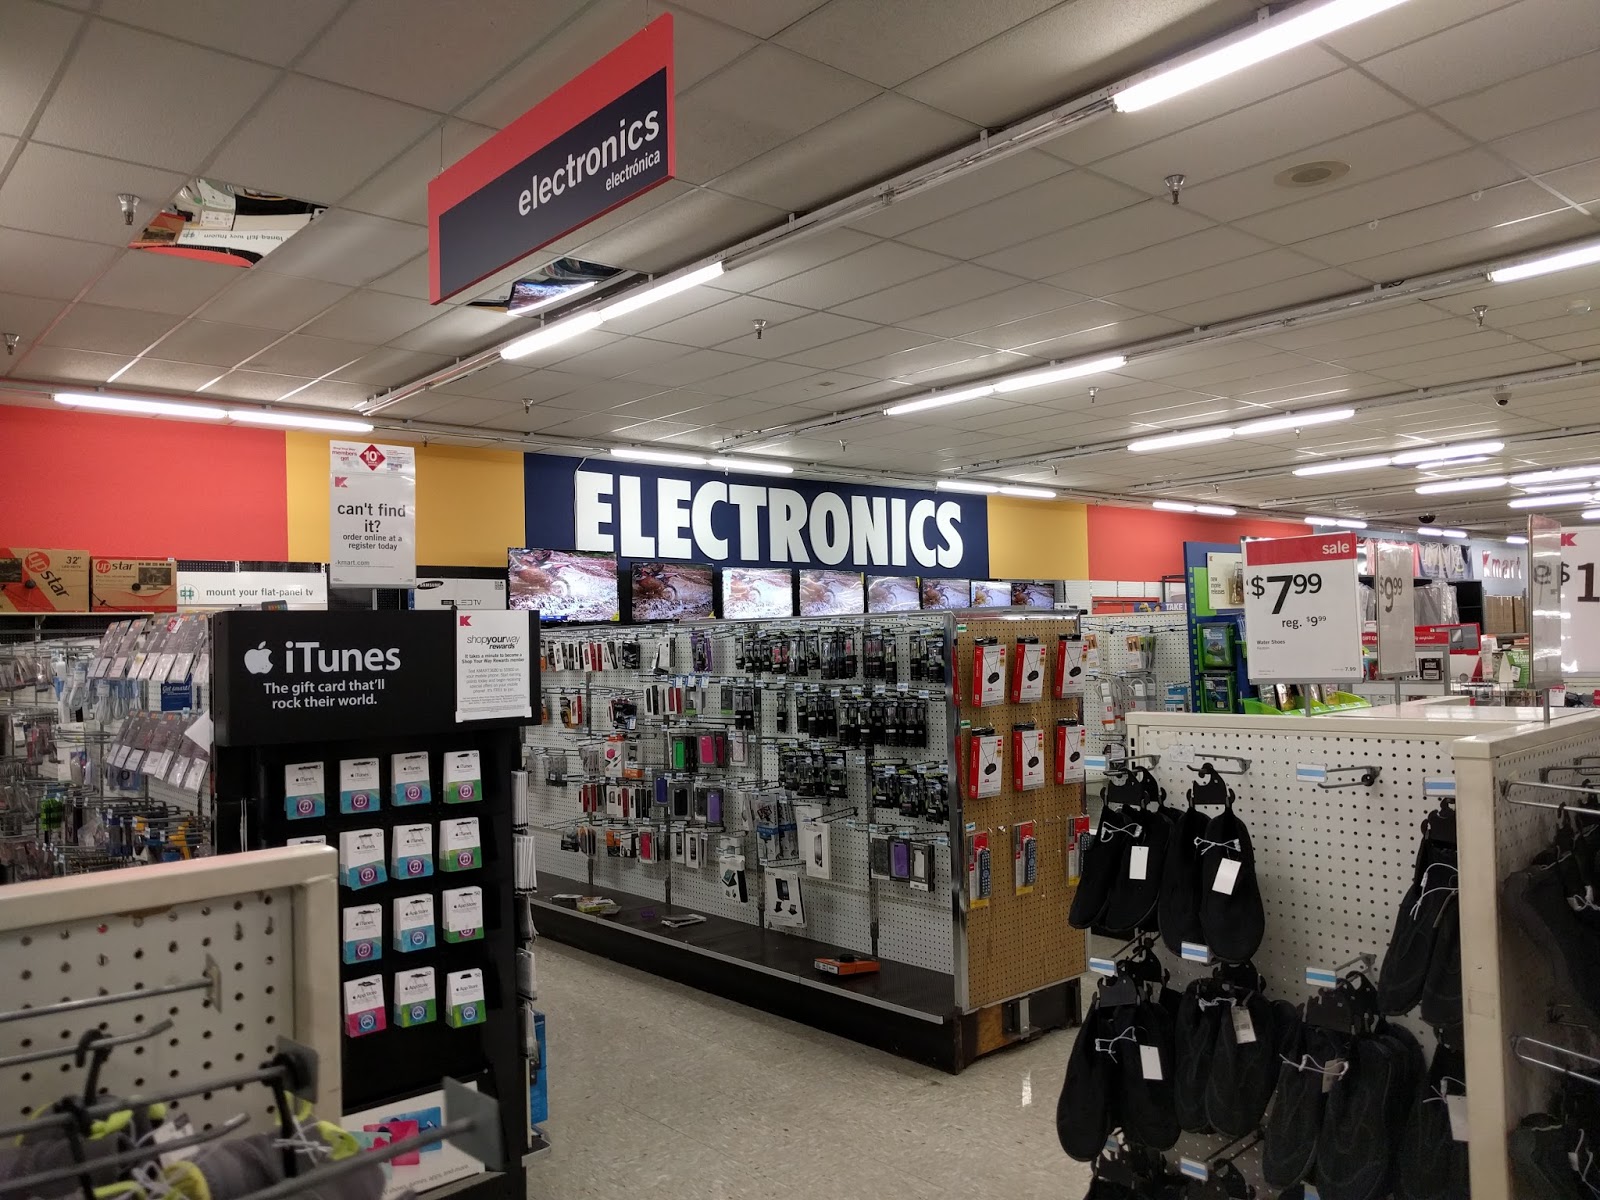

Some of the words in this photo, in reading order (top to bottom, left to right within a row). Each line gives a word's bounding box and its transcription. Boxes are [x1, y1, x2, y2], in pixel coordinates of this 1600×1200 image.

[518, 110, 660, 216] electronics
[605, 150, 661, 191] electrónica
[337, 503, 373, 516] can't
[378, 503, 406, 517] find
[365, 519, 381, 533] it?
[576, 470, 963, 568] ELECTRONICS
[343, 533, 362, 541] order
[348, 542, 376, 551] register
[378, 543, 398, 551] today
[1322, 540, 1350, 555] sale
[112, 561, 134, 571] star
[41, 570, 69, 597] star
[206, 589, 236, 597] mount
[239, 590, 258, 598] your
[1281, 619, 1302, 630] reg.
[285, 641, 401, 673] iTunes
[263, 682, 288, 694] The
[292, 681, 315, 696] gift
[318, 680, 346, 692] card
[272, 697, 301, 709] rock
[304, 695, 335, 708] their
[338, 694, 377, 706] world.
